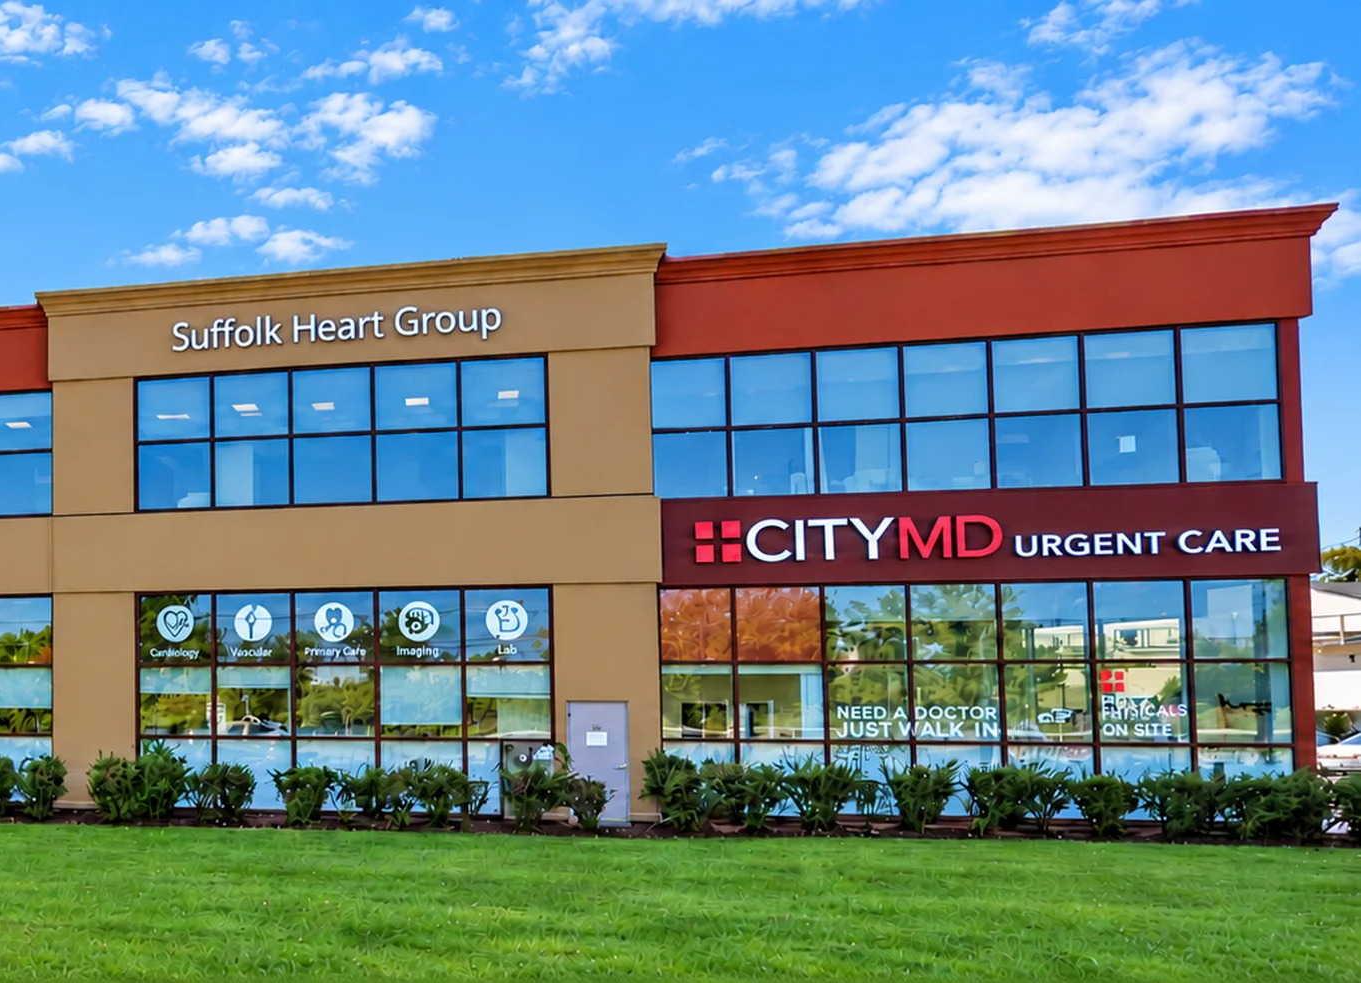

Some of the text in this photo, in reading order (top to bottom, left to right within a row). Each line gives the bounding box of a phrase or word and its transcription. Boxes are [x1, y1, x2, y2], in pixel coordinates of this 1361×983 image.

[171, 306, 503, 352] Suffolk Heart Group
[745, 515, 1282, 562] CITYMD URGENT CARE
[304, 646, 341, 658] Primary
[395, 645, 440, 659] Imaging
[497, 644, 518, 655] Lab
[836, 705, 998, 720] NEED A DOCTOR
[836, 721, 999, 738] JUST WALK IN
[1102, 723, 1173, 737] ON SITE
